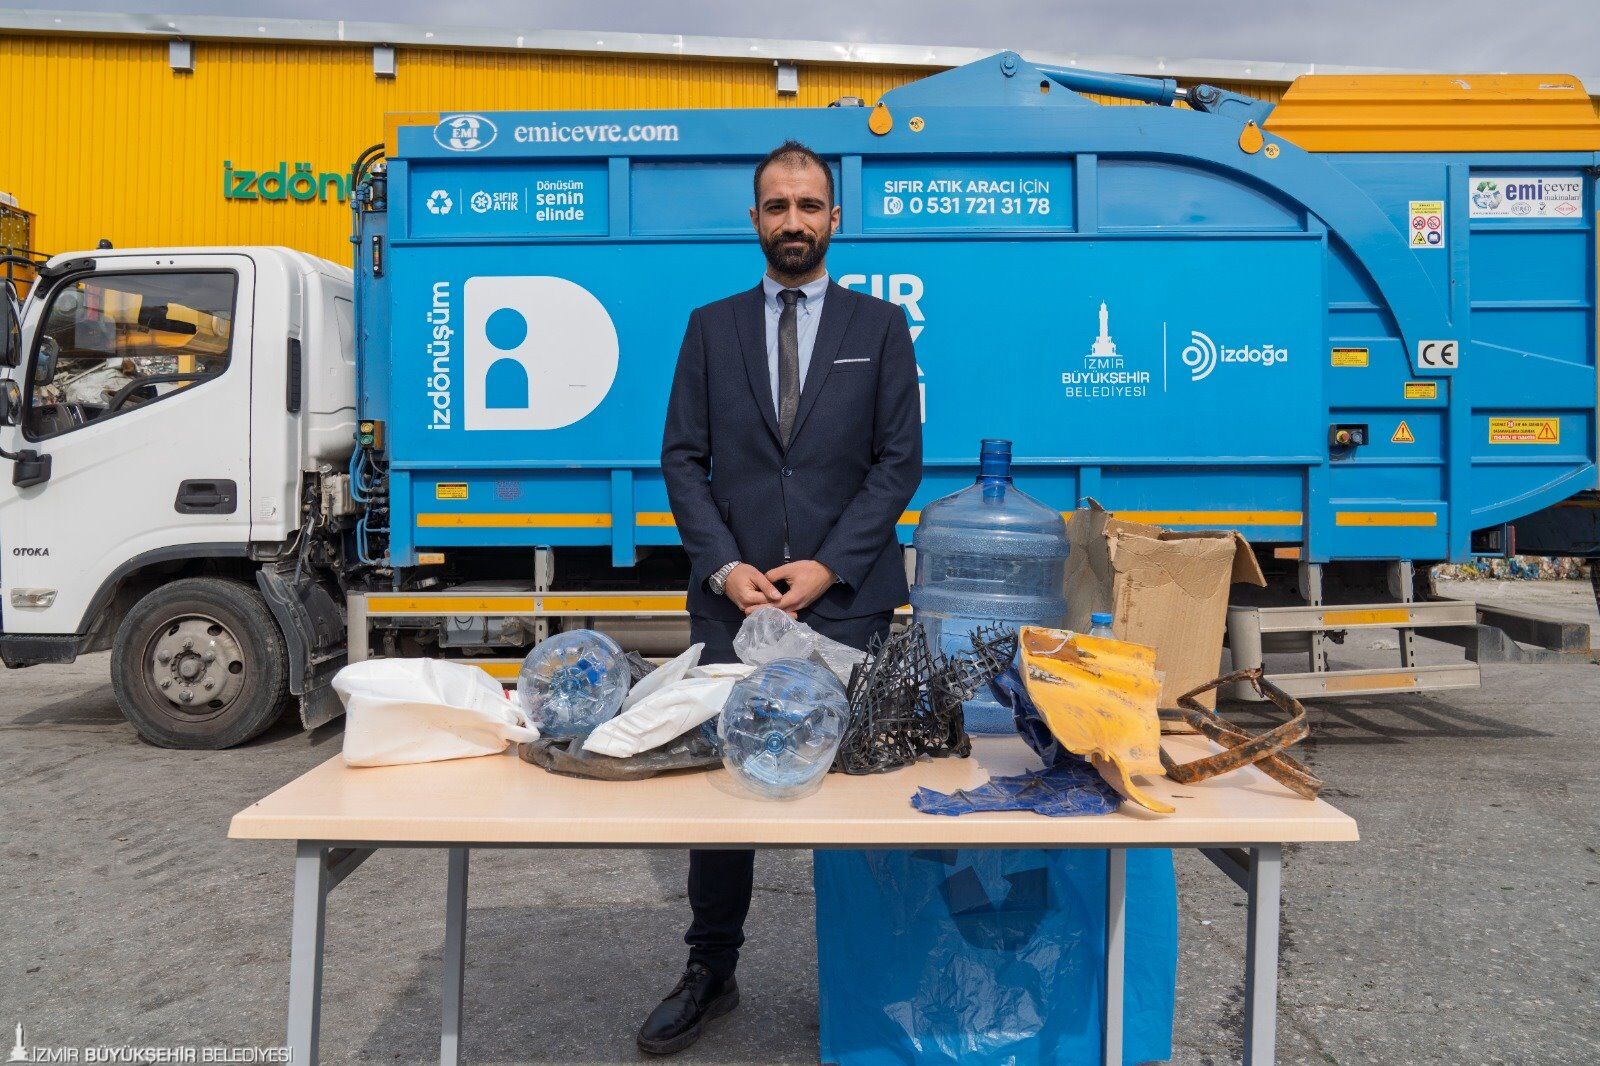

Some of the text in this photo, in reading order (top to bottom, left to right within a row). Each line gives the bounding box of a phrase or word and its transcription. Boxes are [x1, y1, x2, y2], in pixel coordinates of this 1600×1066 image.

[452, 127, 478, 138] EMI
[514, 121, 679, 143] emicevre.com
[536, 181, 583, 191] Dönüşüm
[884, 179, 1050, 195] SIFIR ATIK ARACI İÇİN
[1505, 179, 1580, 201] emi çevre
[493, 192, 518, 201] SIFIR
[536, 192, 584, 205] senin
[493, 202, 518, 211] ATIK
[909, 197, 1050, 214] 0 531 721 31 78
[536, 207, 584, 221] elinde
[427, 281, 454, 430] izdönüşüm
[1221, 344, 1288, 366] izdoğa
[1422, 343, 1454, 366] CE
[1084, 356, 1124, 369] İZMİR
[1062, 369, 1150, 384] BÜYÜKŞEHİR
[1066, 384, 1146, 397] BELEDİYESİ
[13, 547, 50, 556] OTOKA
